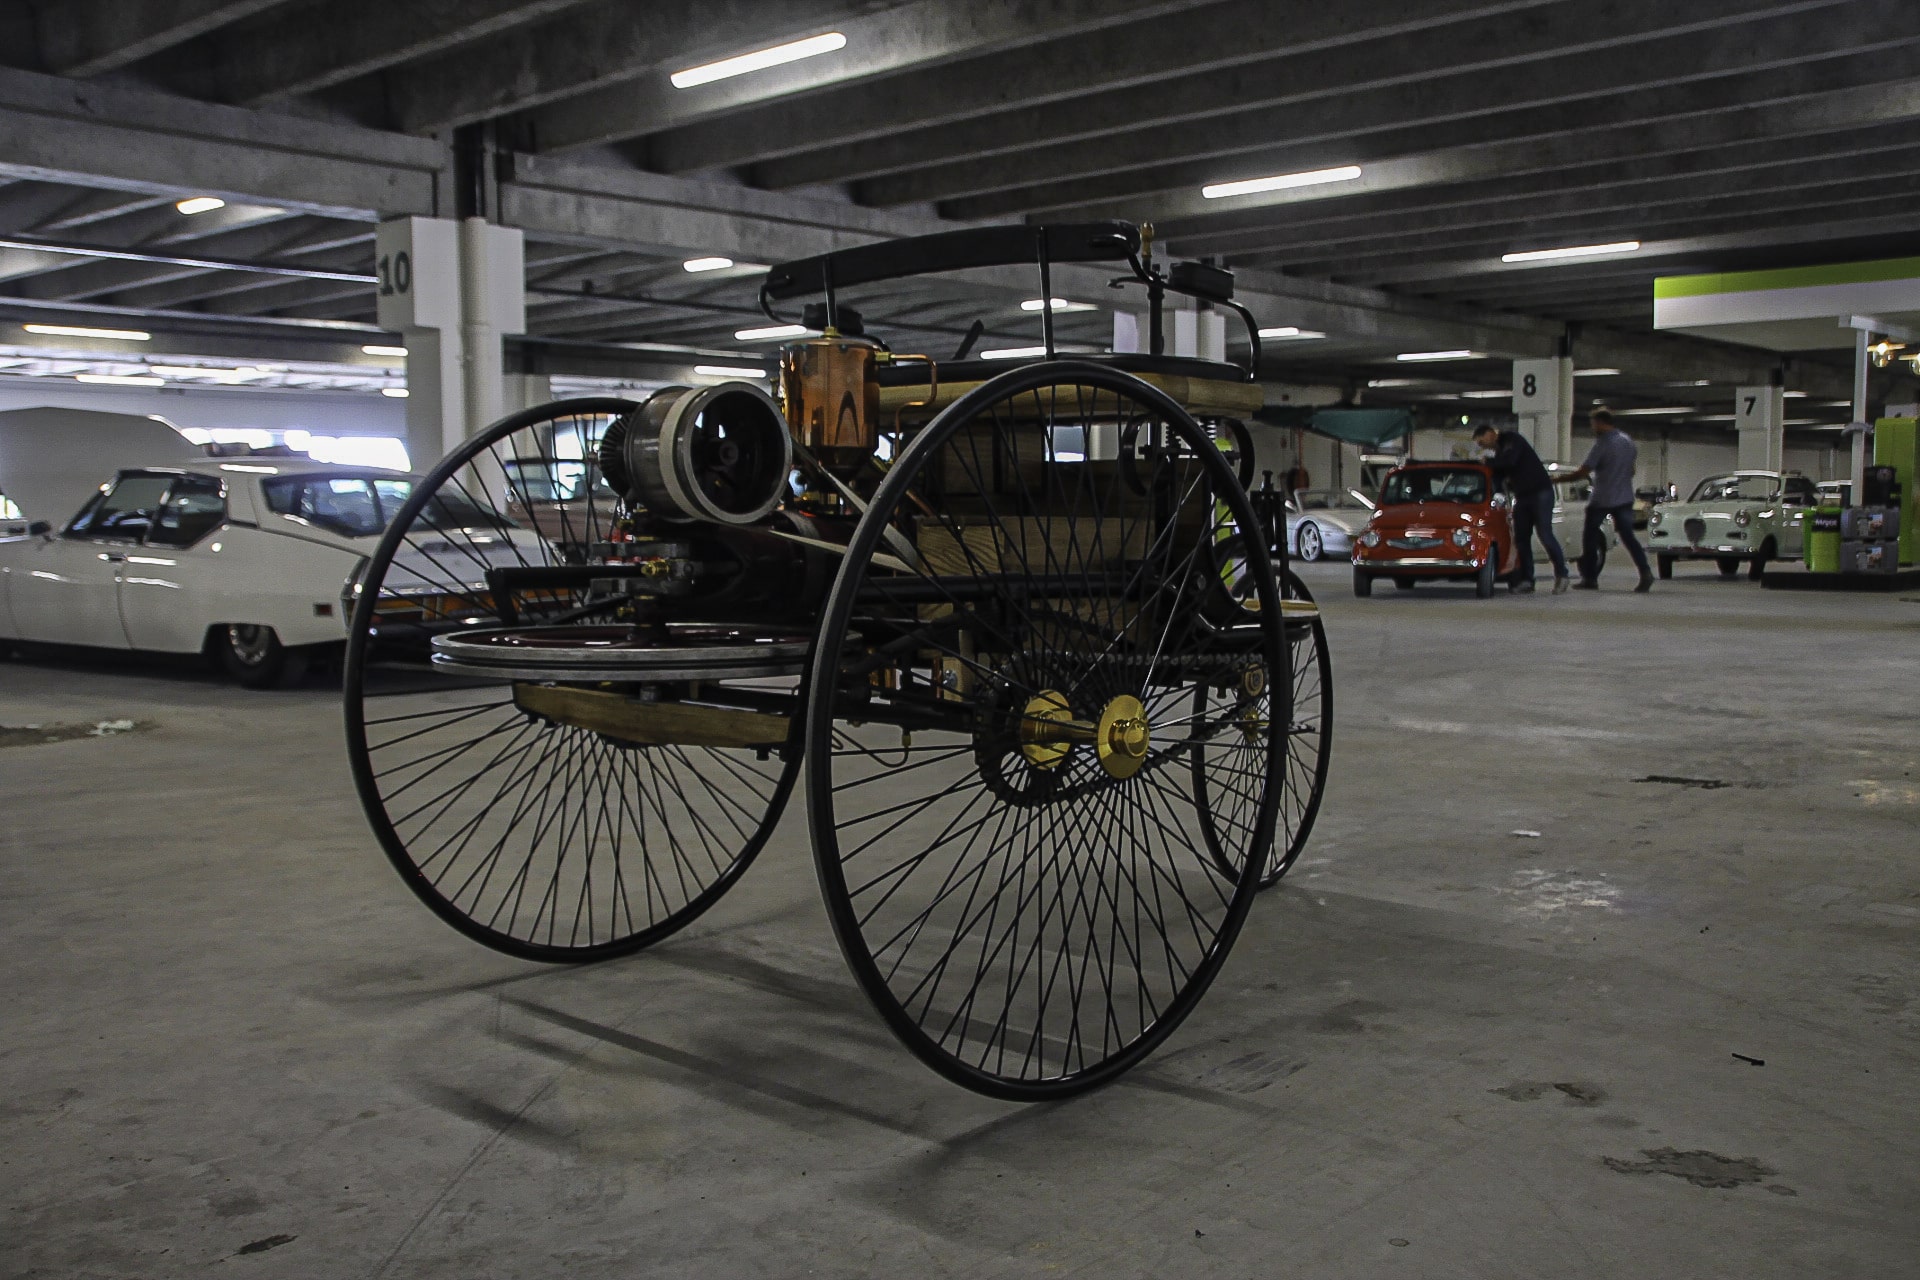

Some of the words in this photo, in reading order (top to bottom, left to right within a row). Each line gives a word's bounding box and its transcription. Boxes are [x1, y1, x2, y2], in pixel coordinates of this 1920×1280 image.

[379, 250, 411, 296] 10
[1522, 373, 1537, 397] 8
[1743, 396, 1756, 416] 7
